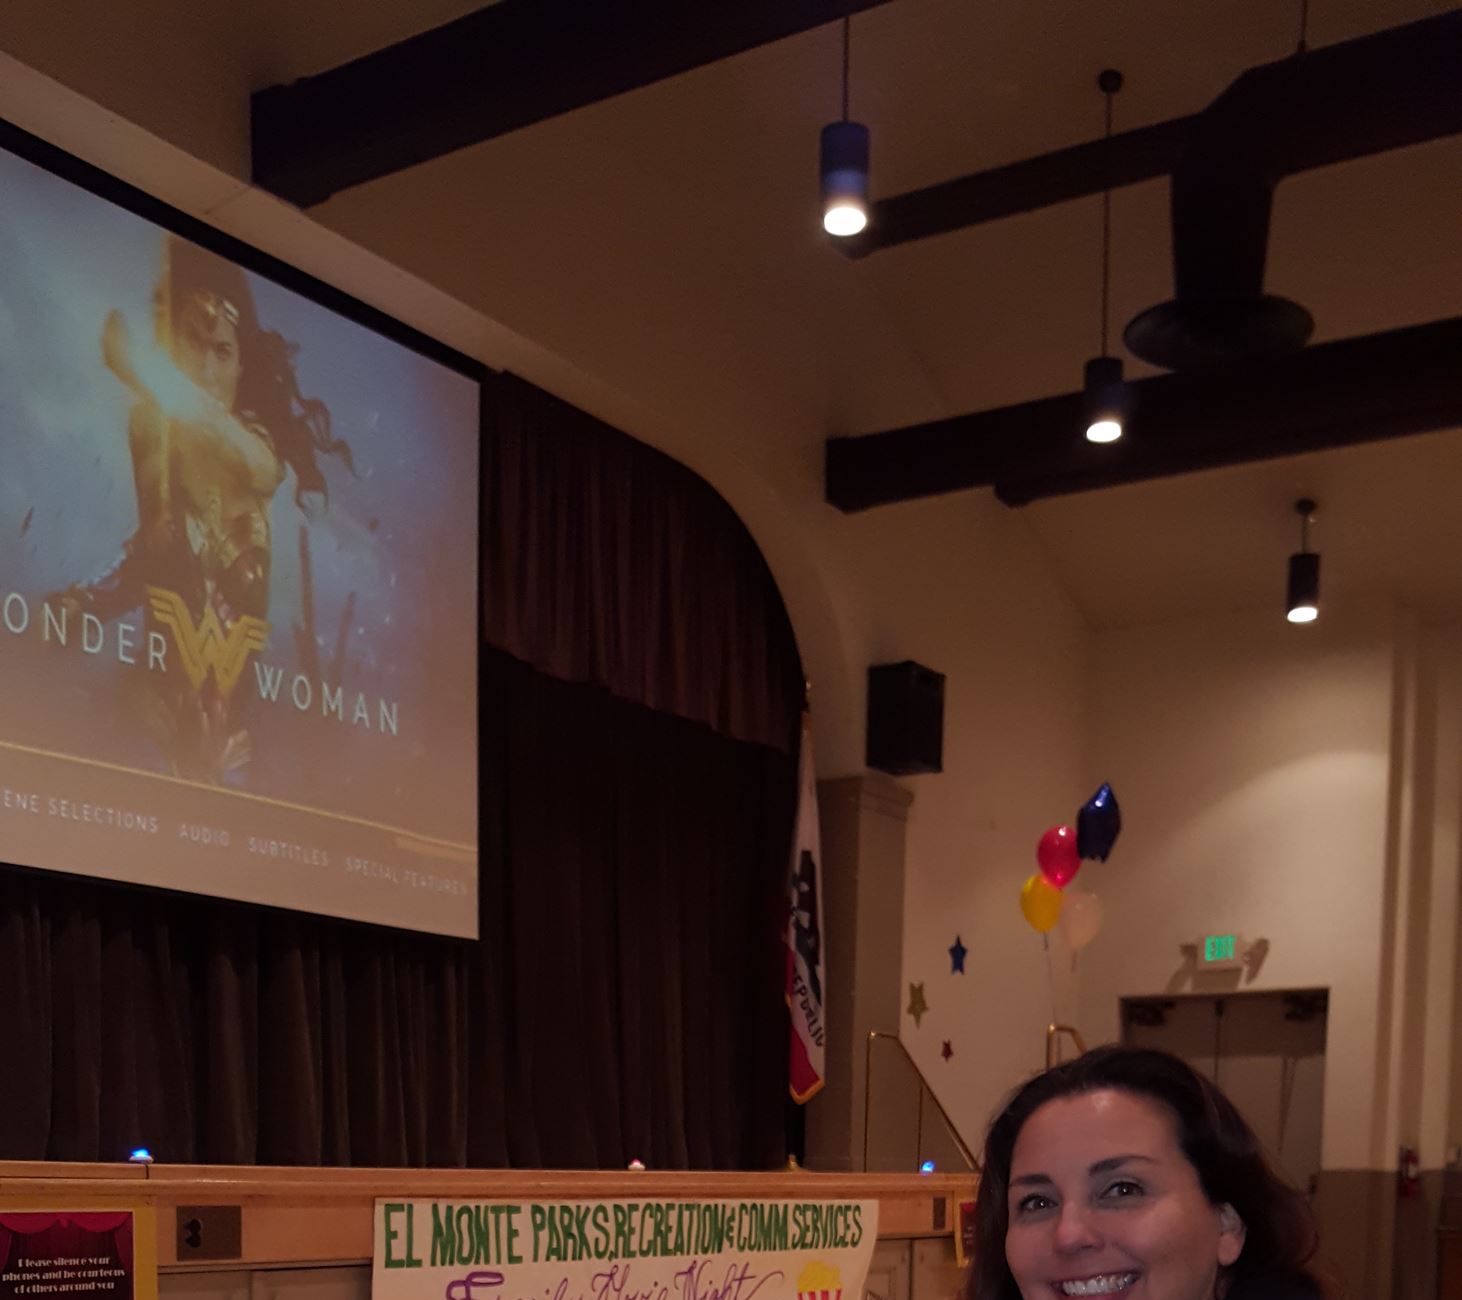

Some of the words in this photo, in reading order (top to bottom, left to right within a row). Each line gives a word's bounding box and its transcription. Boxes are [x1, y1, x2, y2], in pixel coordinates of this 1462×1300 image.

[4, 593, 168, 672] ONDER
[254, 661, 399, 737] WOMAN
[2, 789, 40, 812] ENE
[48, 798, 158, 834] SELECTIONS
[179, 823, 231, 846] AUDIO
[248, 837, 329, 866] SUBTITLES
[345, 856, 399, 884] SPECIAL
[1205, 935, 1235, 960] EXIT
[385, 1202, 423, 1269] EL
[430, 1202, 523, 1267] MONTE
[613, 1202, 726, 1259] RECREATION
[791, 1203, 863, 1250] SERVICES
[17, 1258, 52, 1268] Please
[53, 1257, 87, 1267] silence
[88, 1256, 110, 1266] your
[2, 1272, 40, 1282] phones
[42, 1270, 61, 1280] and
[63, 1270, 76, 1279] be
[77, 1268, 125, 1278] courteous
[14, 1285, 25, 1294] of
[26, 1284, 58, 1294] others
[59, 1282, 95, 1292] around
[97, 1281, 115, 1290] you
